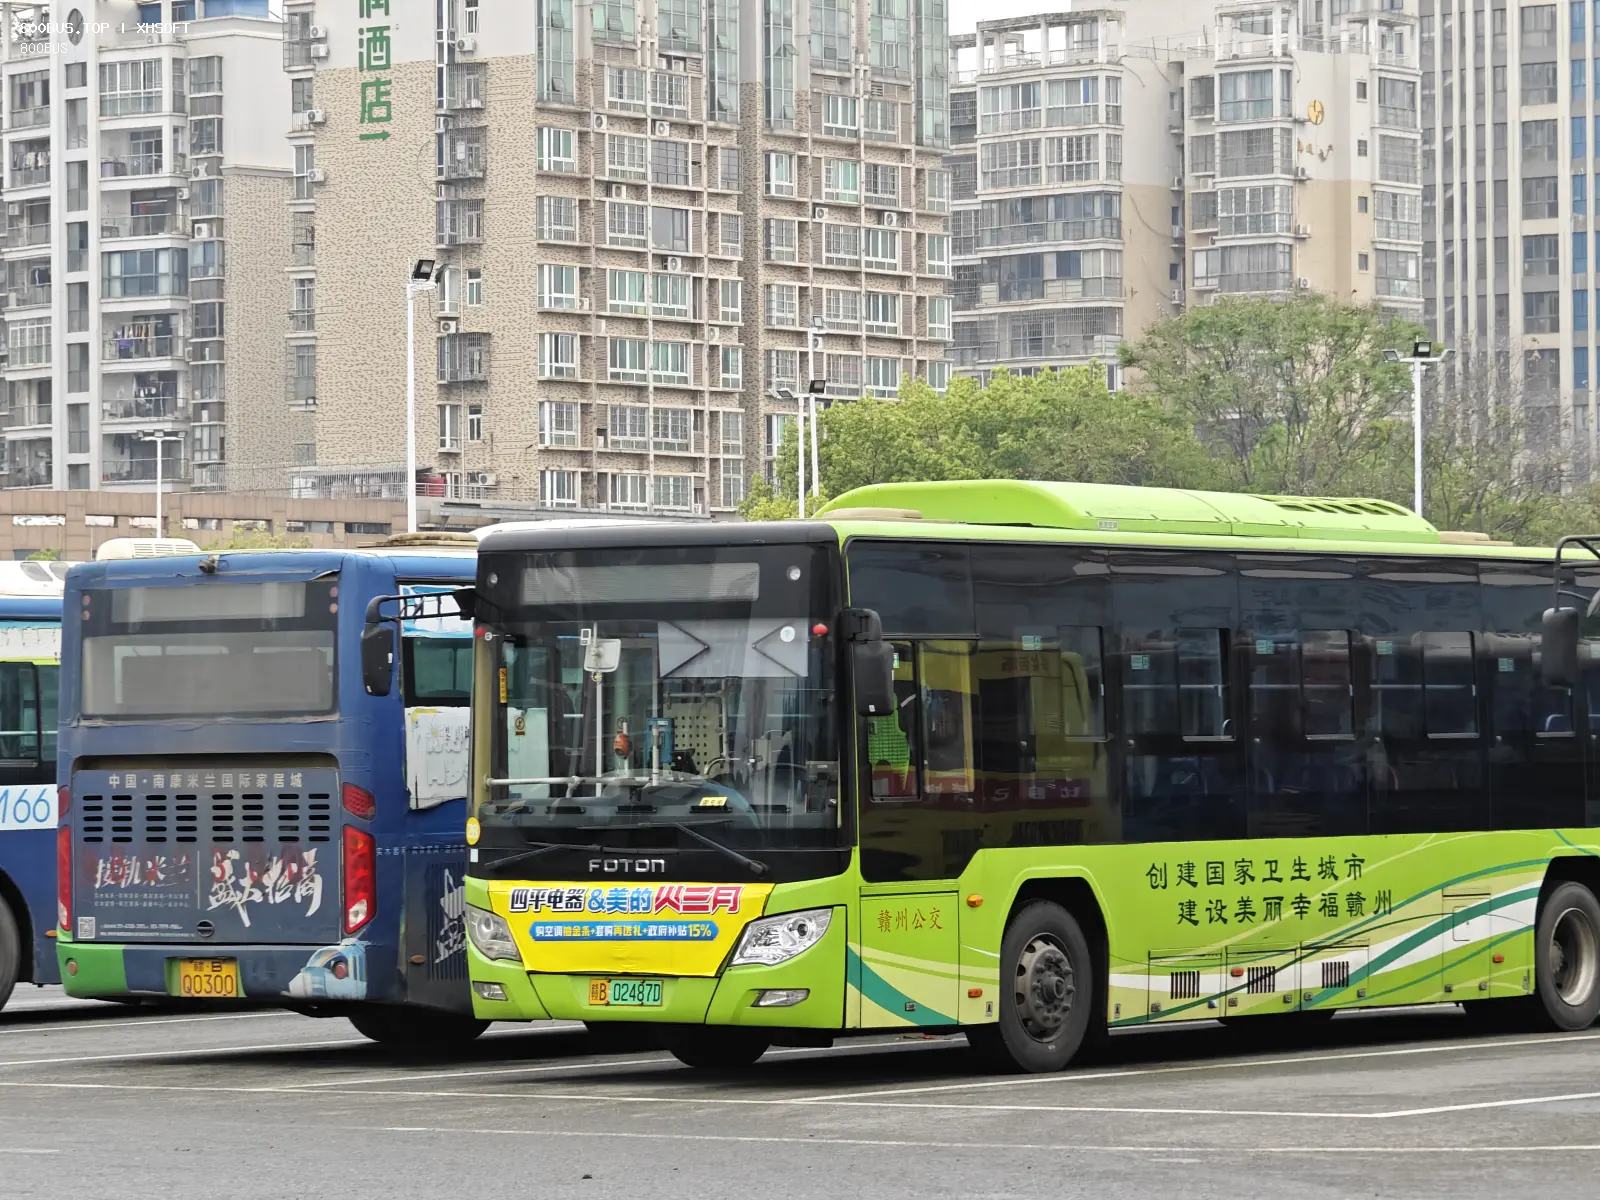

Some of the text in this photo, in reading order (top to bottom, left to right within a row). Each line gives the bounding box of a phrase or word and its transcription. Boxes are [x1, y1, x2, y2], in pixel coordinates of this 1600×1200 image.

[108, 773, 302, 789] 中国·南康米兰国际家居城
[589, 859, 666, 873] FOTON
[1145, 853, 1366, 889] 创建国家卫生城市
[1176, 889, 1393, 926] 建设美丽幸福赣州
[877, 907, 943, 933] 赣州公交
[183, 974, 234, 994] Q0300
